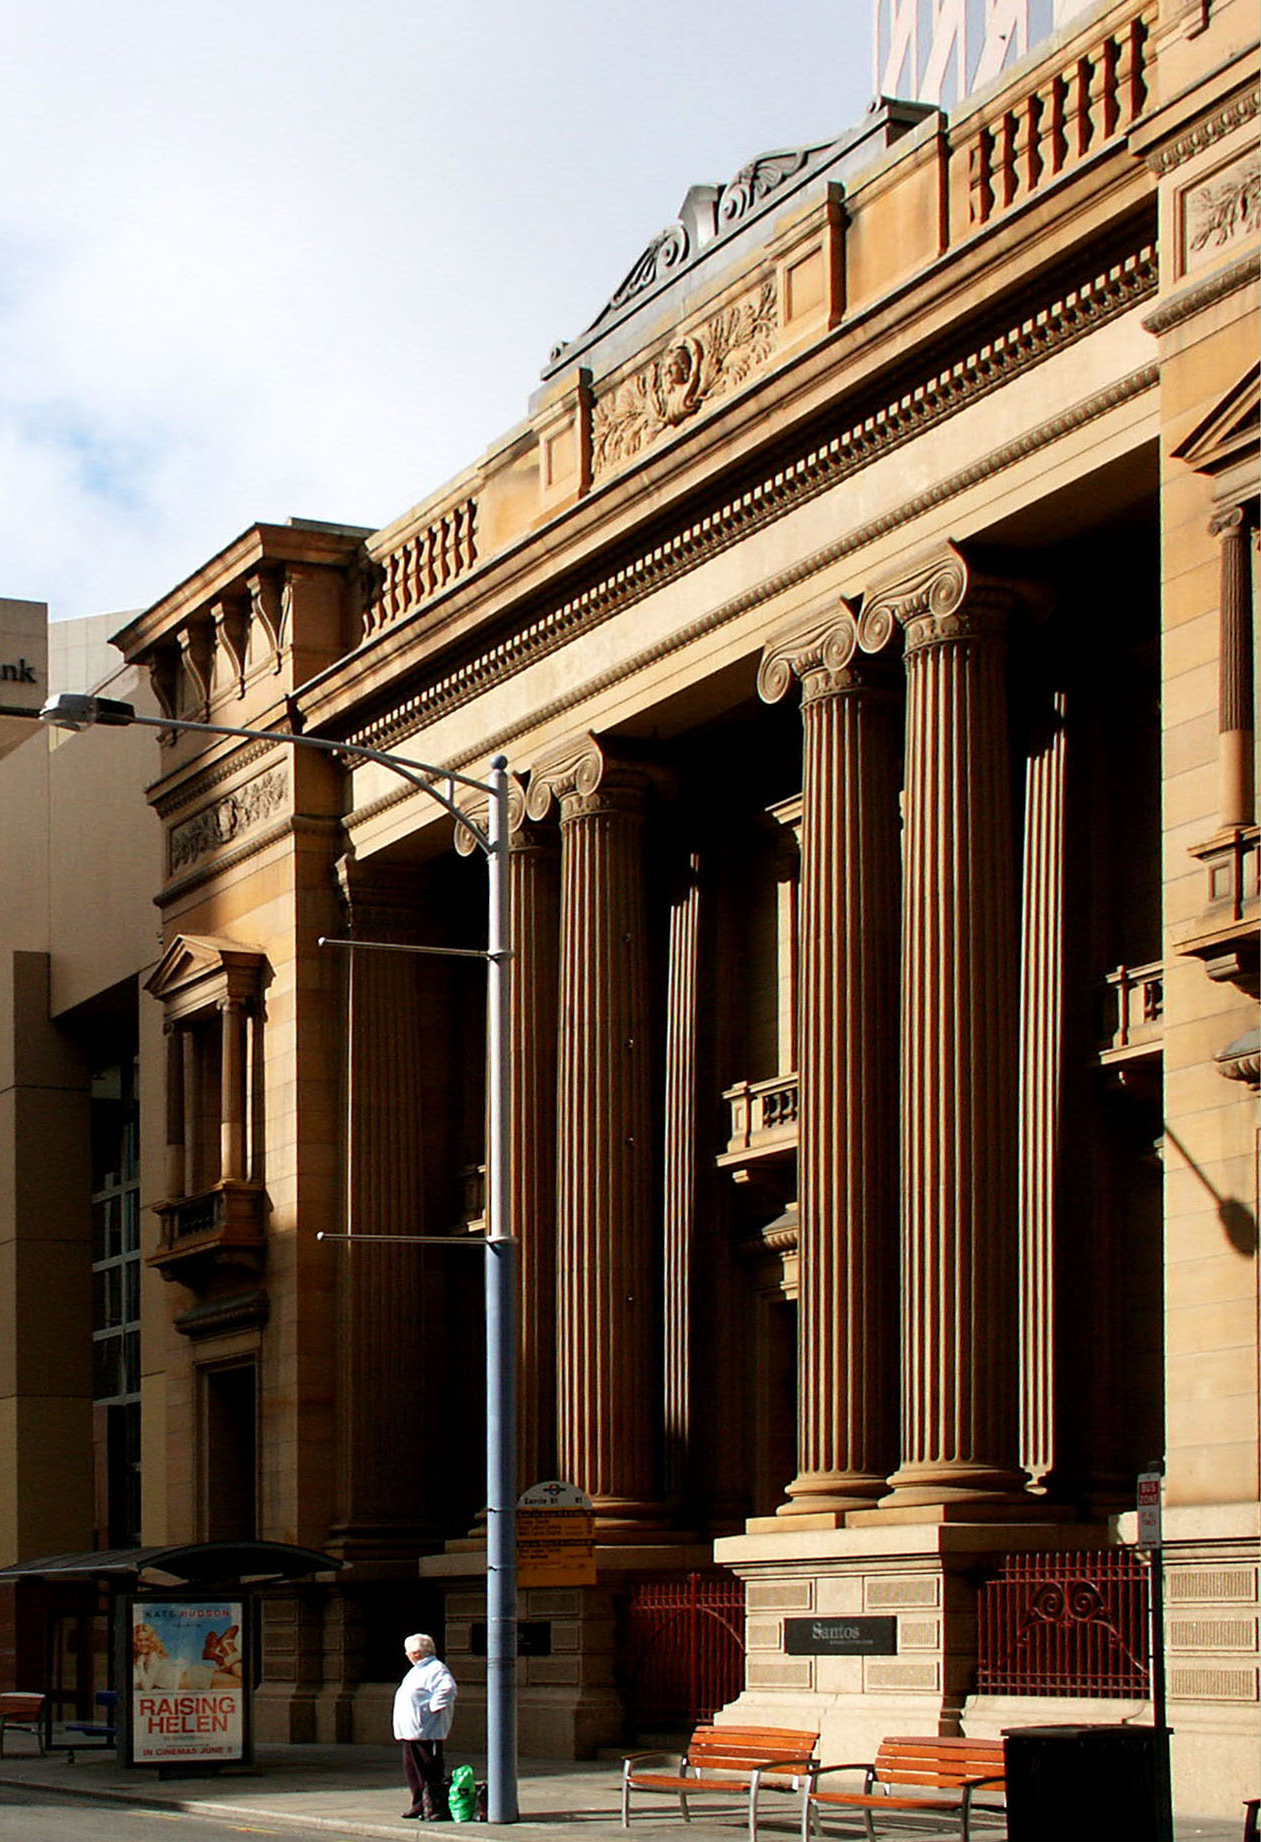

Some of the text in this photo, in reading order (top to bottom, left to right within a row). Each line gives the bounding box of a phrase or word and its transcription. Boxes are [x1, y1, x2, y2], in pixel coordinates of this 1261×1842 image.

[180, 1608, 231, 1618] HUDSON
[811, 1622, 860, 1640] Santos
[139, 1696, 236, 1717] RAISING
[147, 1715, 229, 1734] HELEN
[143, 1748, 153, 1757] IN
[155, 1746, 197, 1756] CINEMAS
[199, 1746, 224, 1755] JUNE
